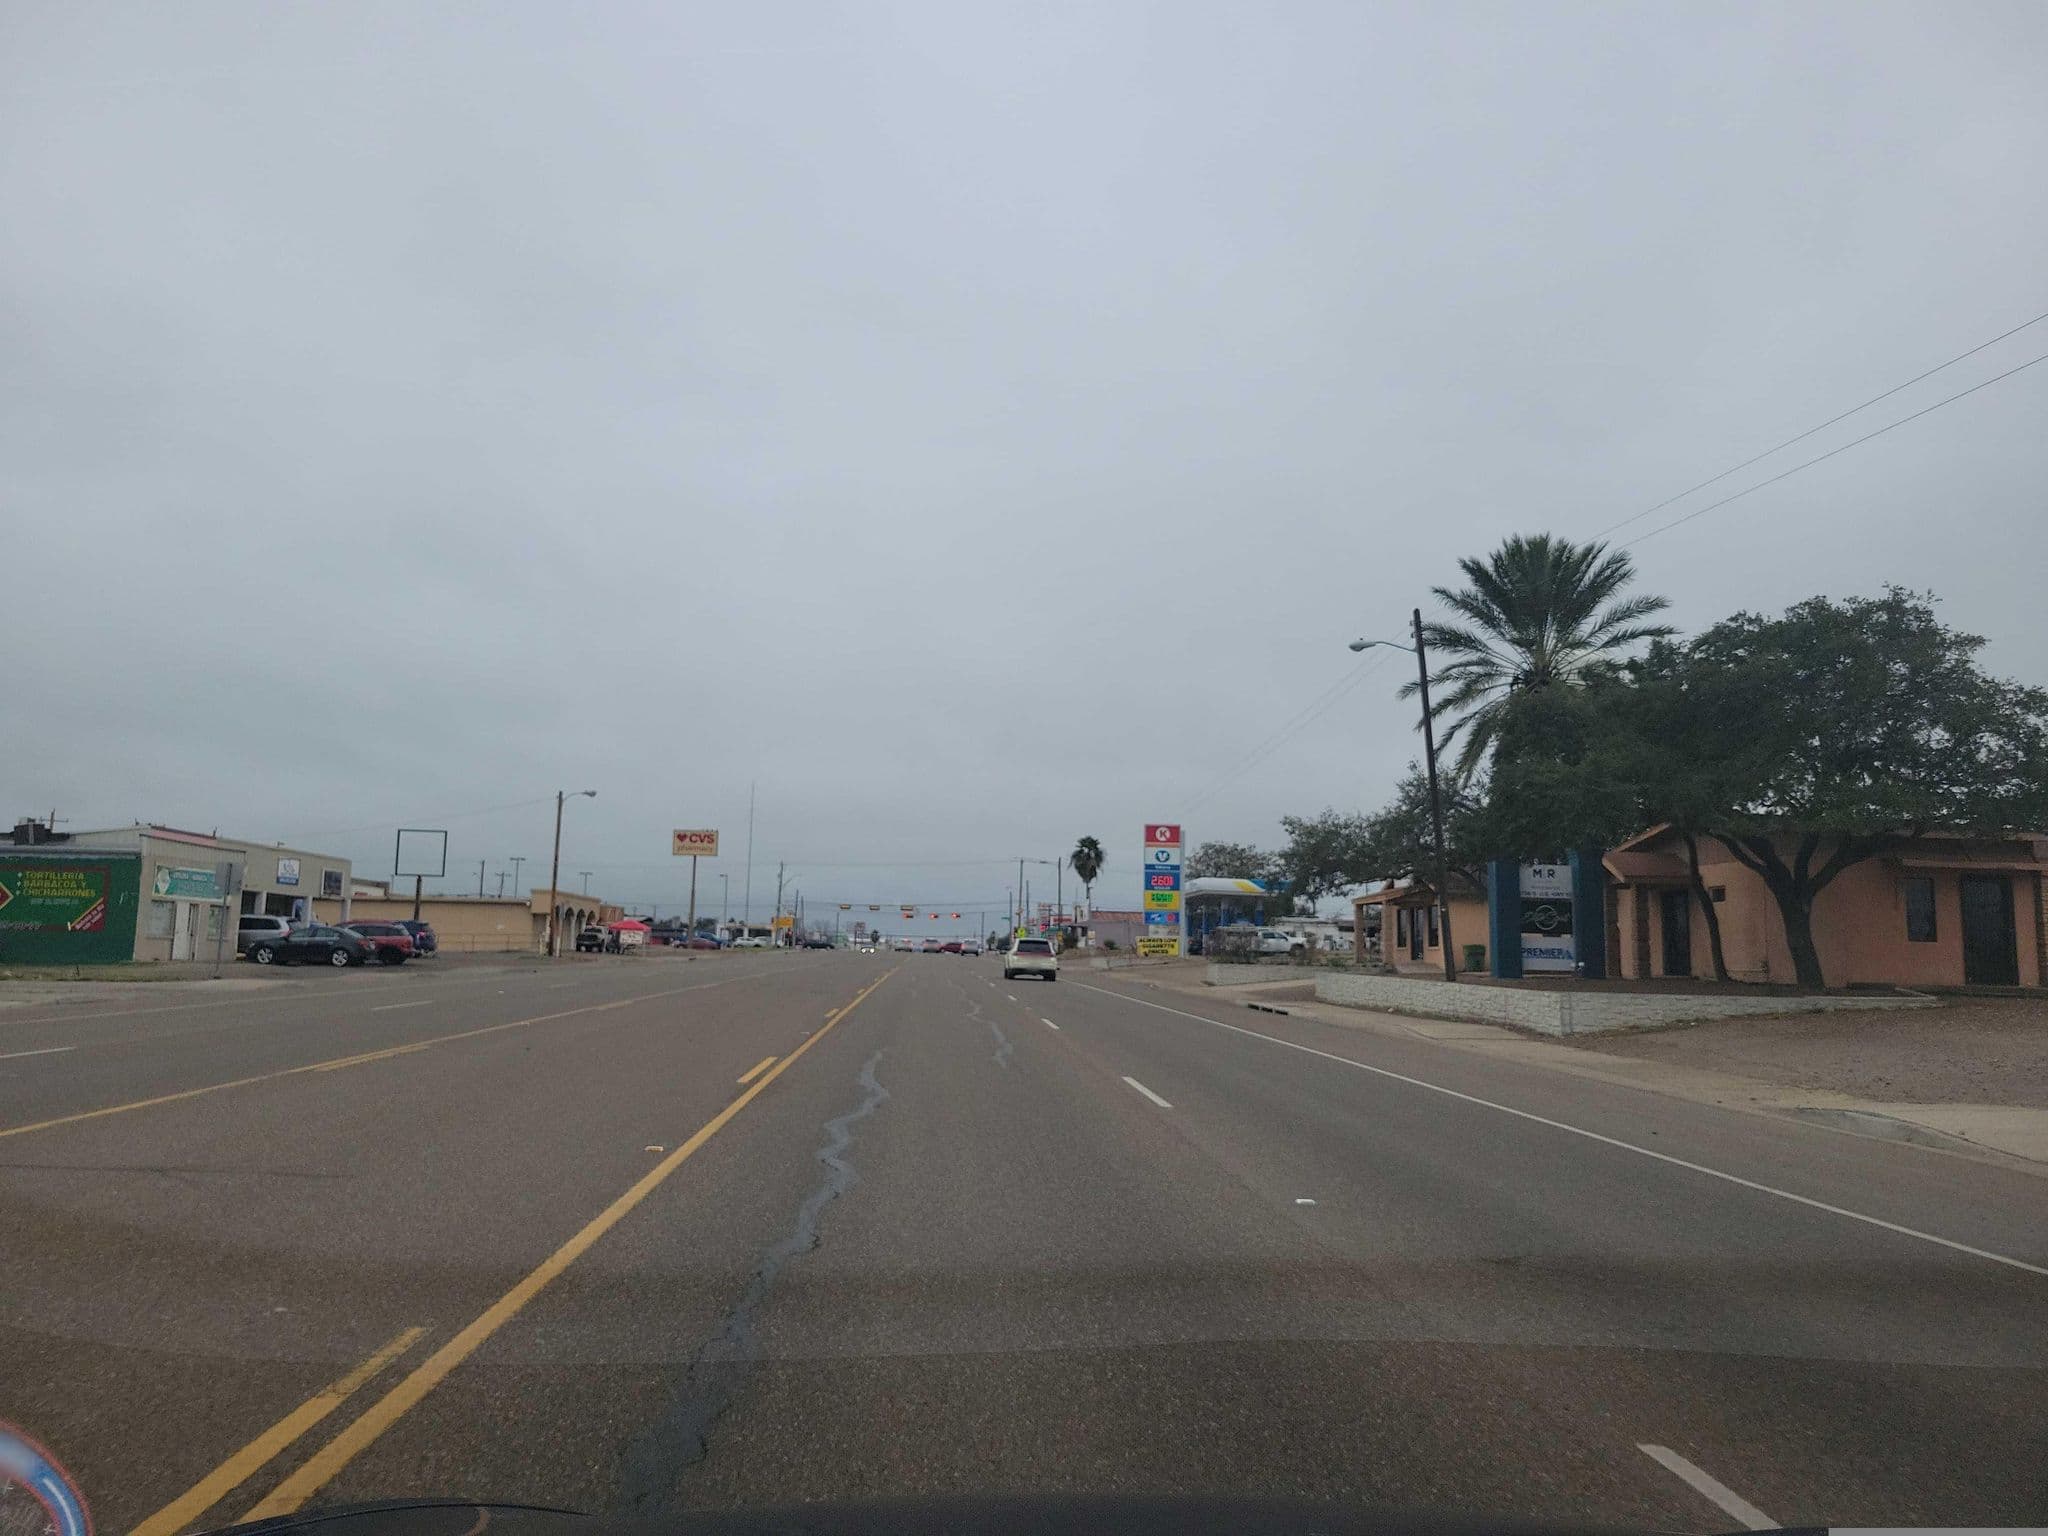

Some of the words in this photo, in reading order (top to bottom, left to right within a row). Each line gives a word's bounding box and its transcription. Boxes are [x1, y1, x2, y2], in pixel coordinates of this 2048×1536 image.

[689, 833, 714, 844] CVS
[1159, 829, 1168, 839] K
[23, 880, 77, 888] BARBACOA
[82, 880, 88, 888] Y
